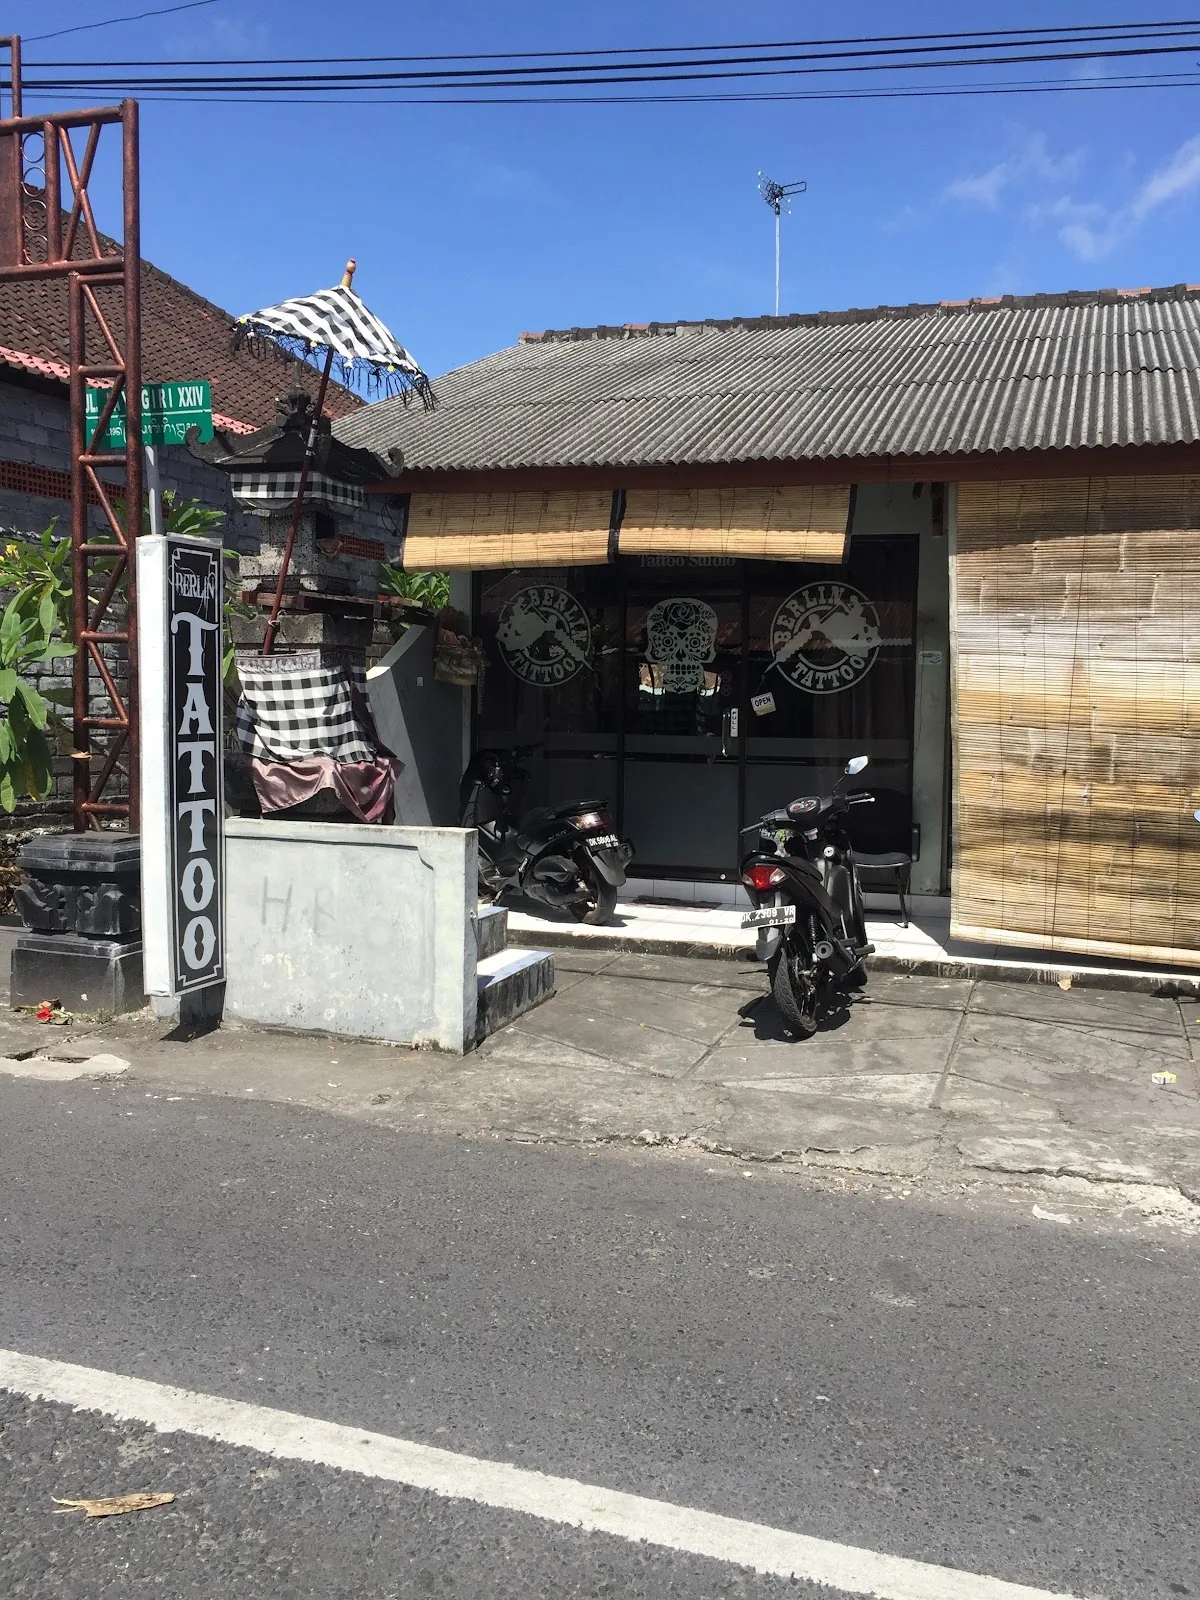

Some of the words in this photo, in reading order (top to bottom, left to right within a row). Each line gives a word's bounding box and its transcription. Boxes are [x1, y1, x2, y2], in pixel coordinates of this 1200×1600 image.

[85, 393, 98, 413] JL.
[178, 385, 204, 407] XXIV
[638, 555, 685, 568] Tattoo
[174, 572, 215, 599] BERLIN
[528, 588, 587, 643] BERLIN
[773, 585, 846, 644] BERLIN
[509, 653, 576, 683] TATTOO
[790, 655, 866, 690] TATTOO
[755, 696, 771, 706] OPEN
[171, 611, 218, 971] TATTOO
[784, 906, 794, 916] VR
